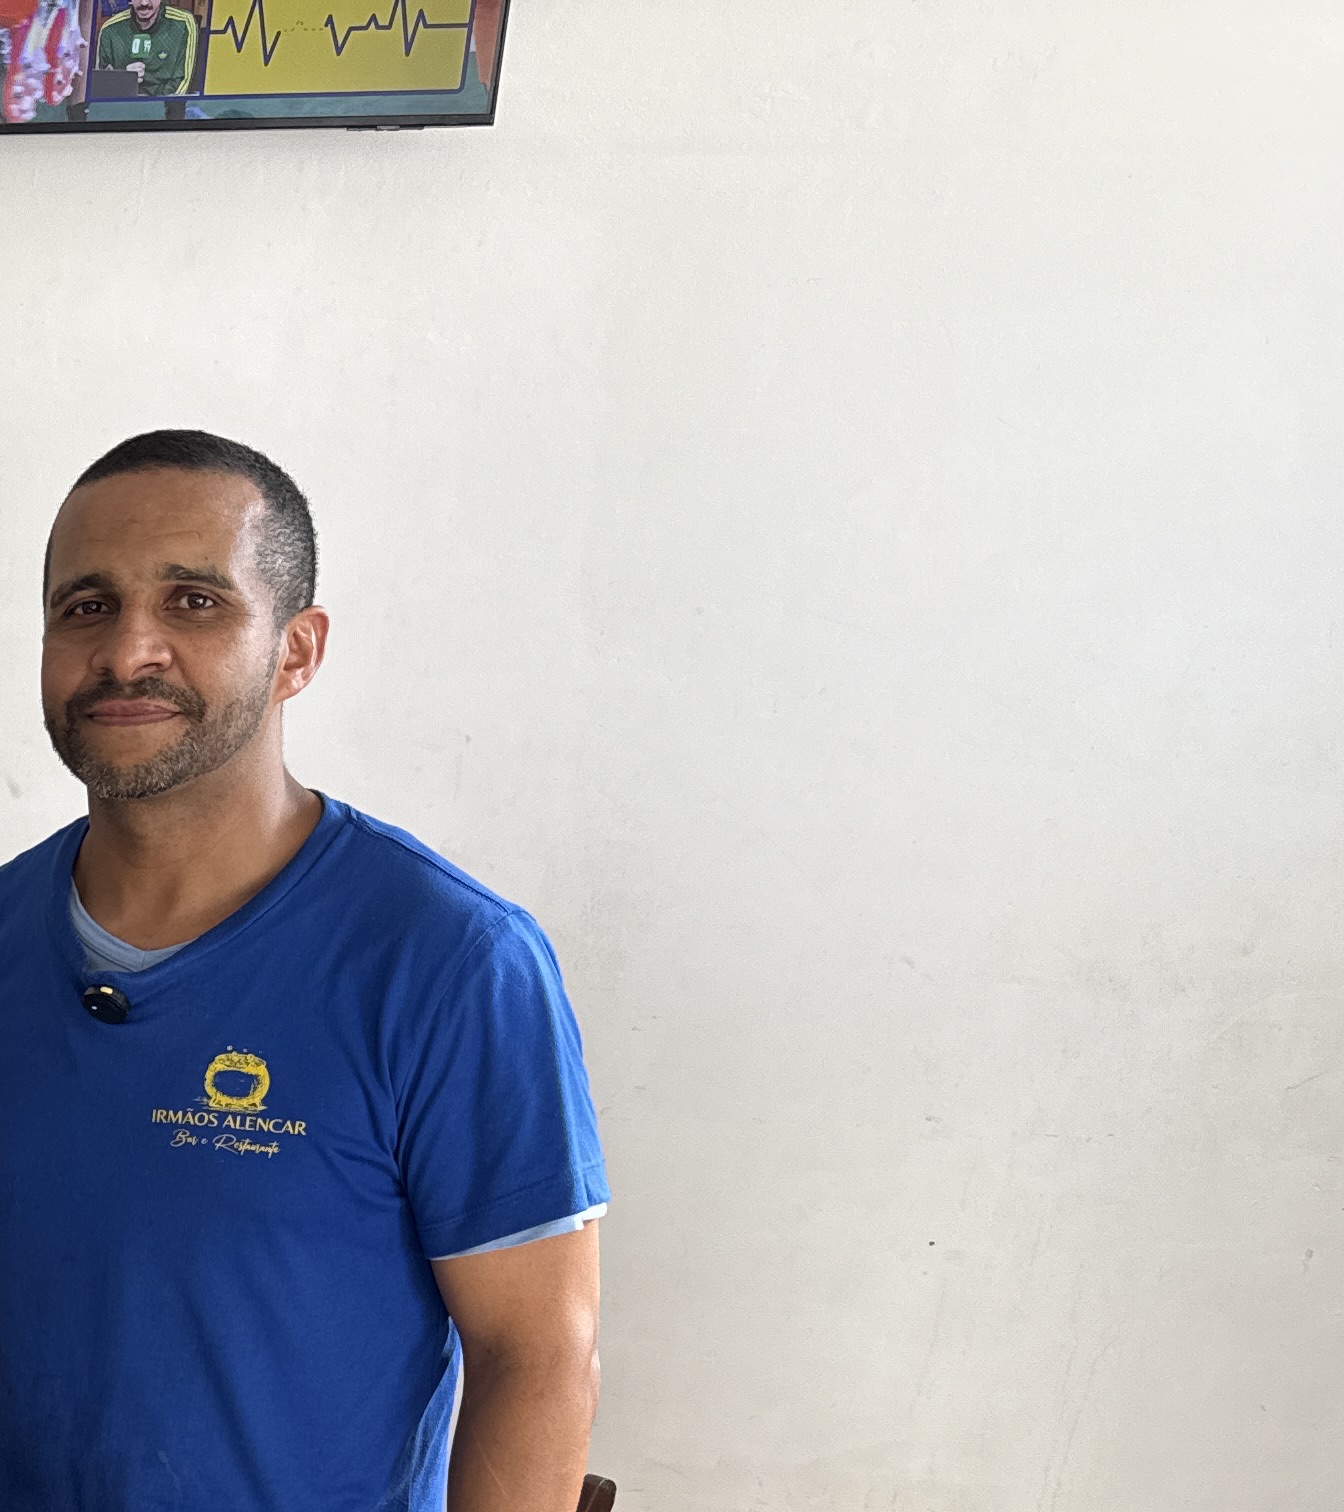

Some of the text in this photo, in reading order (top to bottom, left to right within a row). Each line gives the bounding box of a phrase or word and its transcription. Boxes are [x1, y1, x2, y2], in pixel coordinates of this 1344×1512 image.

[151, 1107, 306, 1136] IRMÃOS ALENCAR
[212, 1133, 281, 1159] Restaurante
